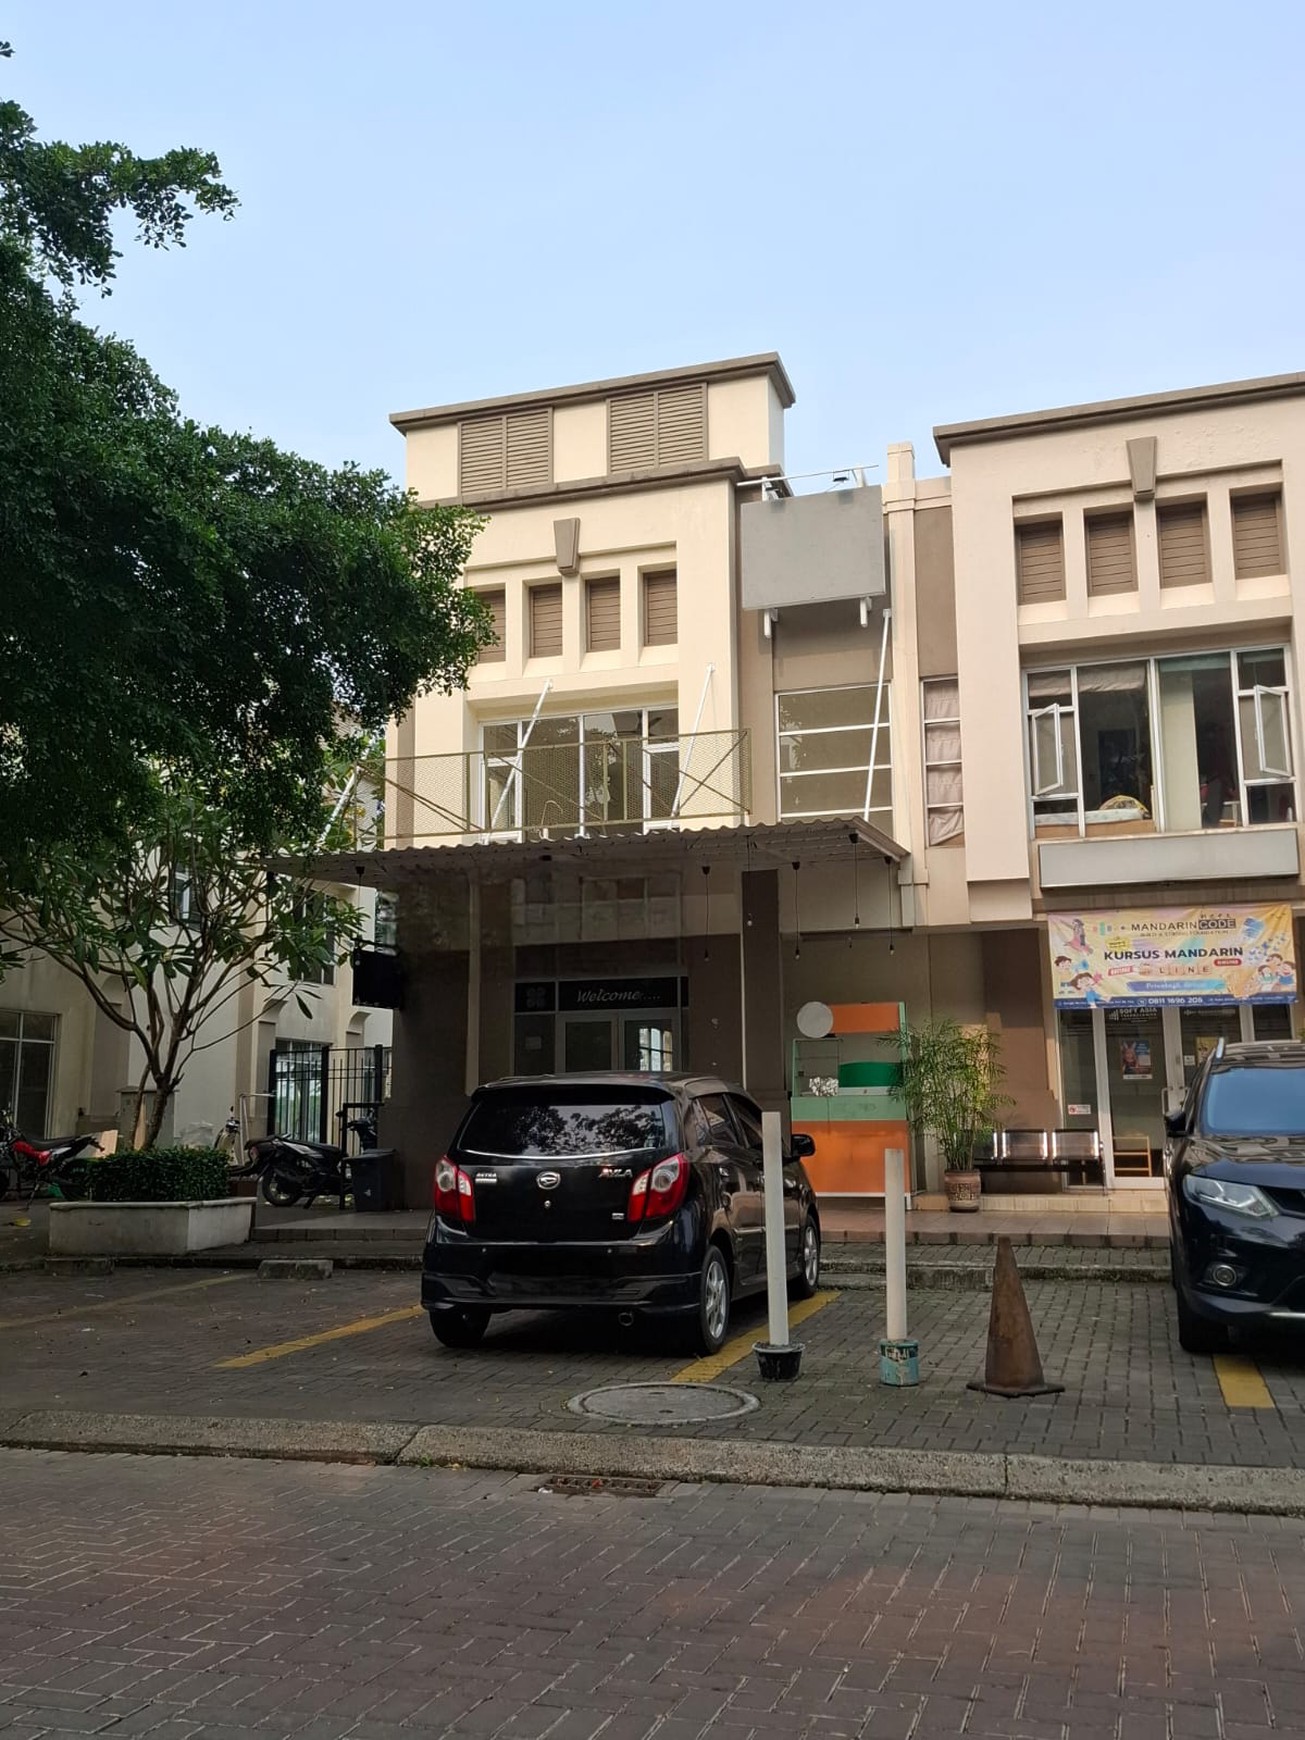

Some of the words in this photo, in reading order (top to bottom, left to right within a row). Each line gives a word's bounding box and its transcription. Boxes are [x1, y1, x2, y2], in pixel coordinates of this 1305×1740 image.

[1131, 921, 1198, 931] MANDARIN
[1199, 919, 1236, 929] CODE
[1104, 950, 1160, 960] KURSUS
[1164, 947, 1243, 959] MANDARIN
